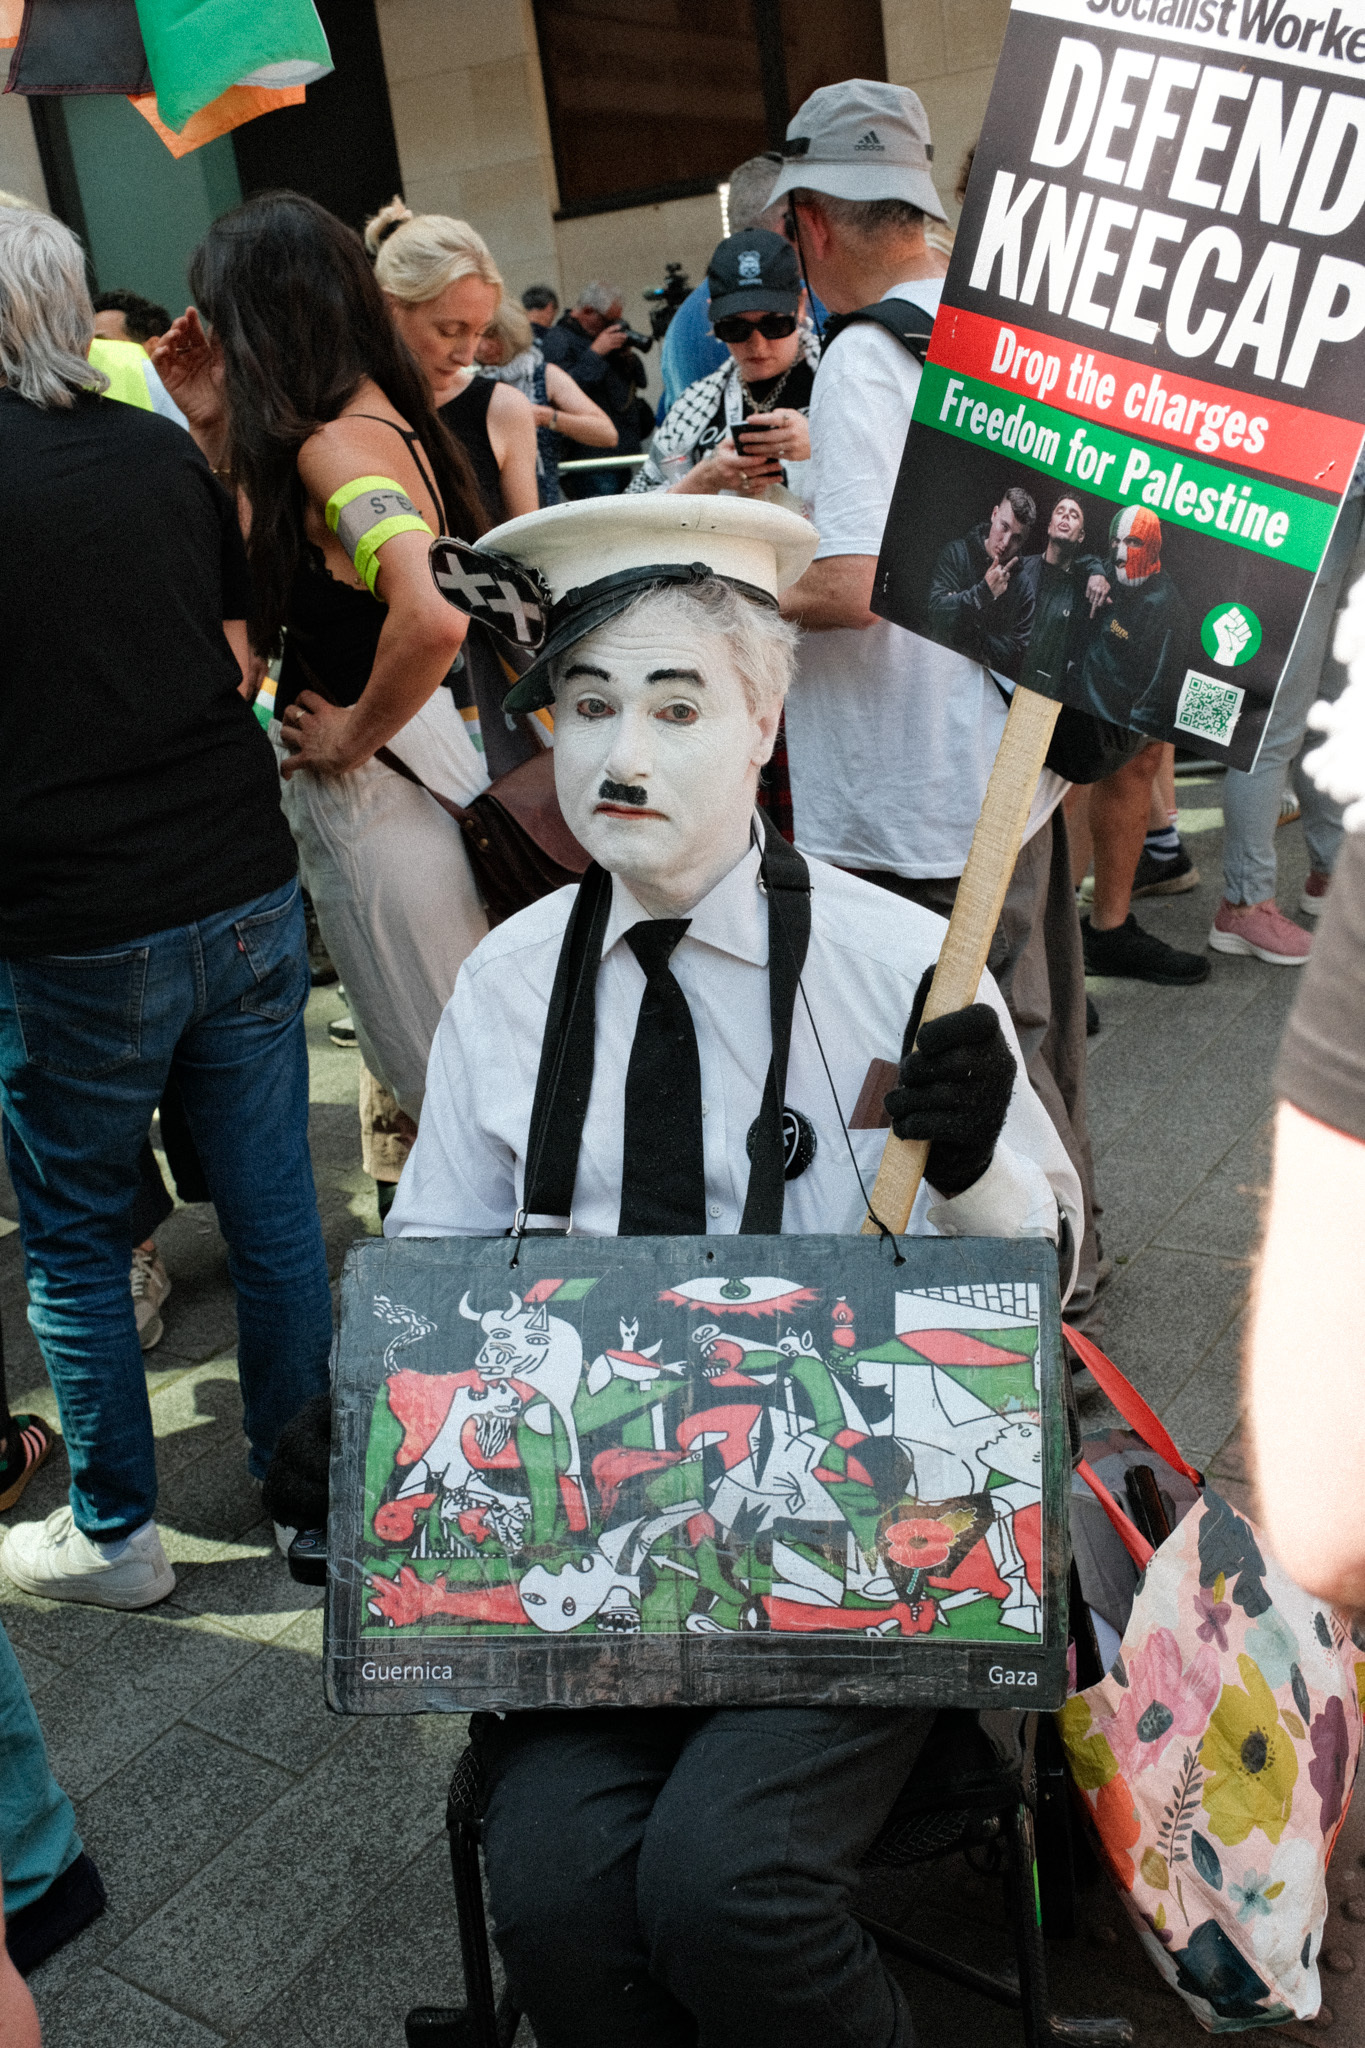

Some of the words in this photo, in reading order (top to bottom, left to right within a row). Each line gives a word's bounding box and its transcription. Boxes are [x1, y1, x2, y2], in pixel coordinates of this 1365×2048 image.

[1030, 36, 1365, 236] DEFEND
[968, 169, 1365, 389] KNEECAP
[938, 377, 1061, 466] Freedom
[1066, 428, 1116, 485] for
[1119, 447, 1289, 549] Palestine
[990, 327, 1060, 400] Drop
[1065, 353, 1116, 410] the
[1123, 374, 1269, 453] charges
[361, 1661, 453, 1680] Guernica
[988, 1665, 1038, 1686] Gaza
